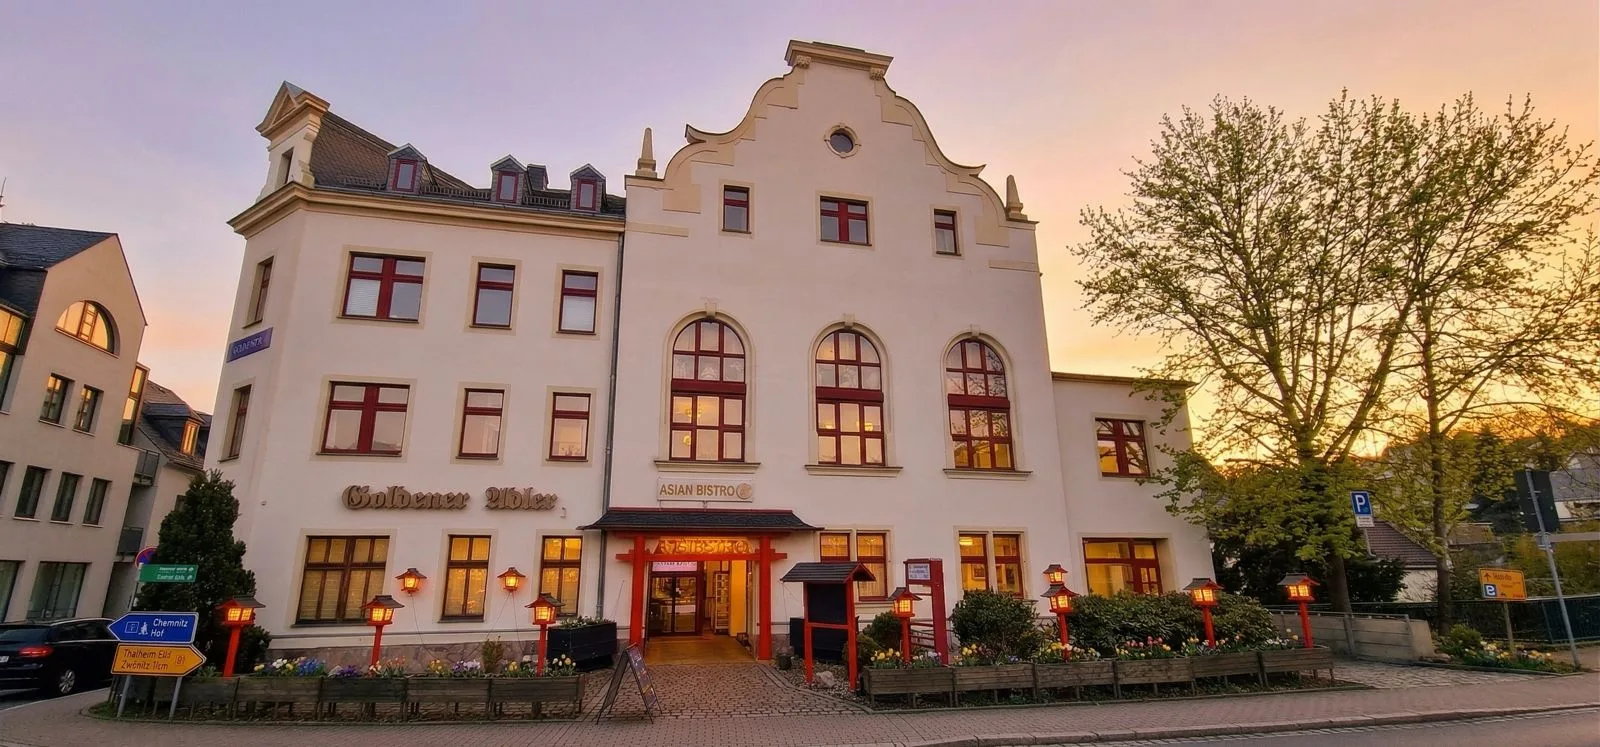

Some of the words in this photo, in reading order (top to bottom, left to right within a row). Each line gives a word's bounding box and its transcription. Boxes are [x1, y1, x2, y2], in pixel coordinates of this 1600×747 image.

[660, 484, 693, 496] ASIAN
[696, 484, 735, 497] BISTRO
[341, 485, 471, 511] Goldener
[485, 486, 558, 511] Adler
[1355, 494, 1366, 513] P
[153, 618, 188, 628] Chemnitz
[150, 629, 164, 637] Hof
[124, 649, 156, 659] Thalheim
